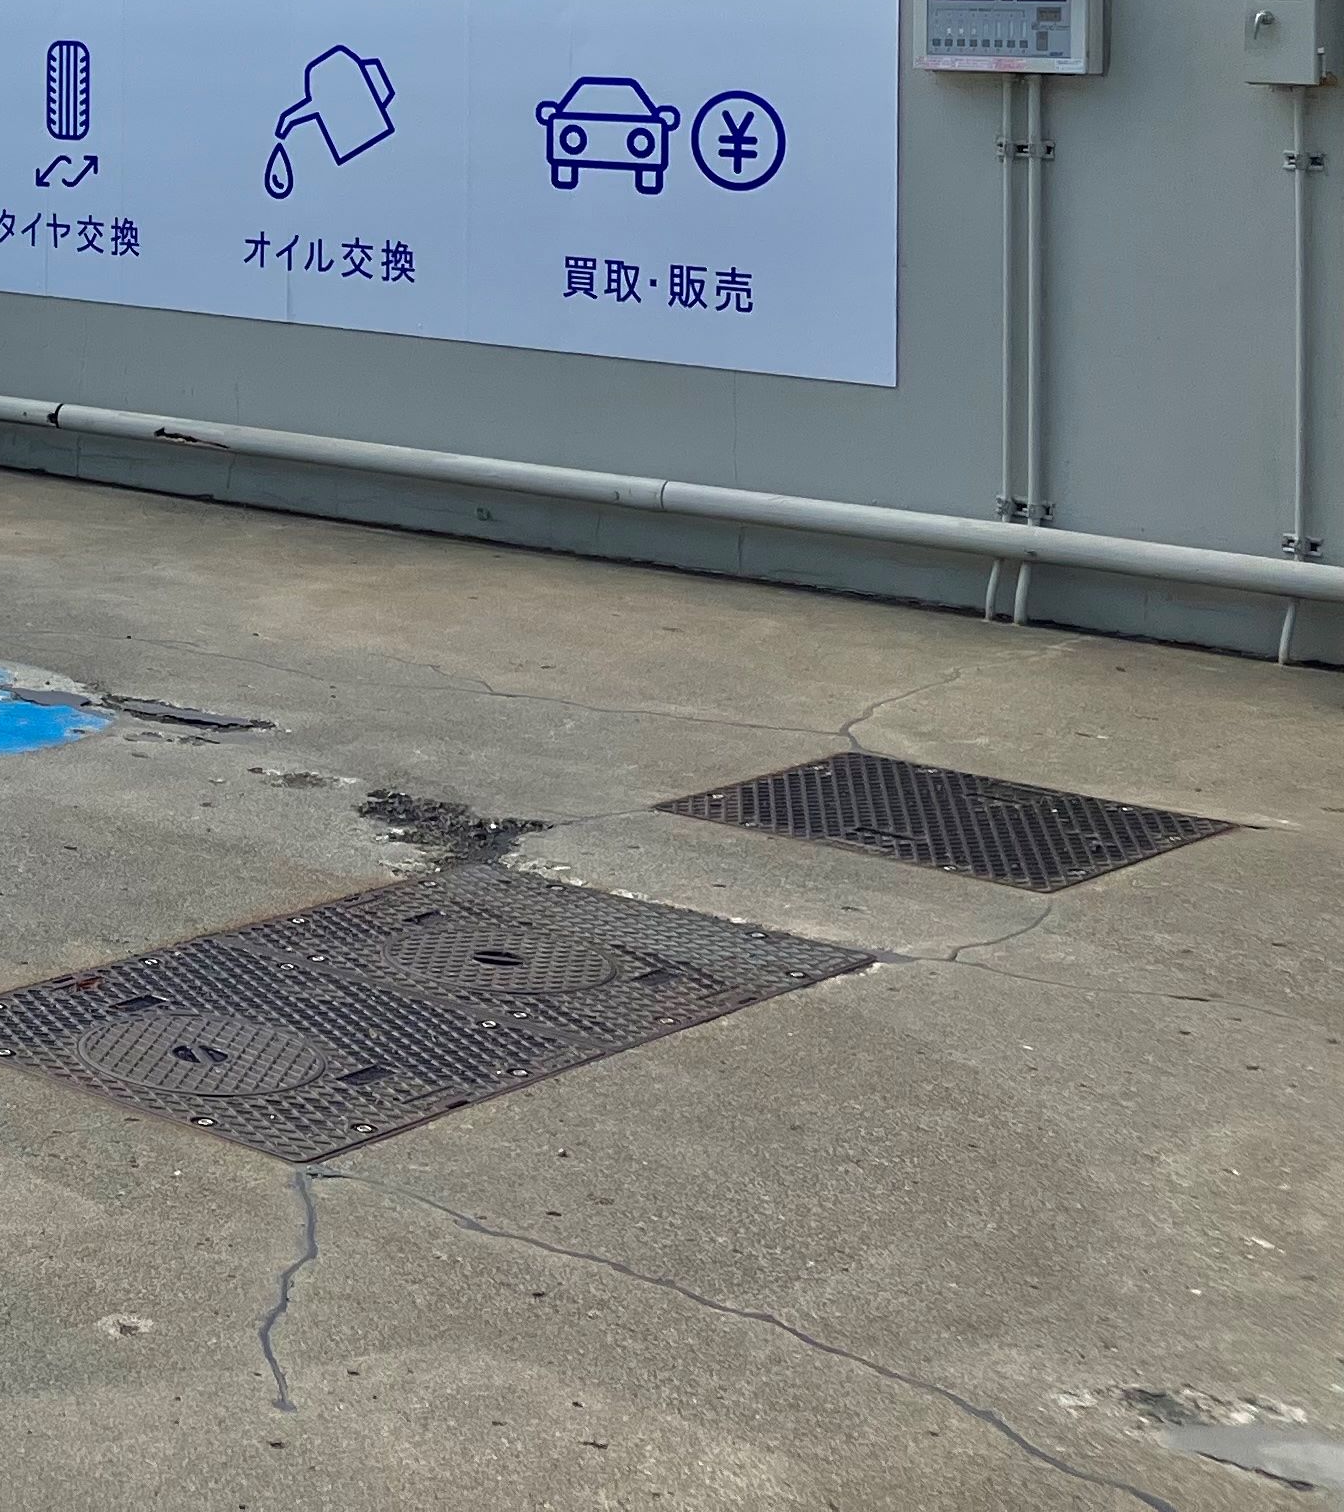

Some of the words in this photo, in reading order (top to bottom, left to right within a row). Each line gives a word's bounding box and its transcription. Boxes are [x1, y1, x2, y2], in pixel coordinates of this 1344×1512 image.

[244, 231, 415, 283] オイル交換
[563, 256, 753, 312] 買取・販売
